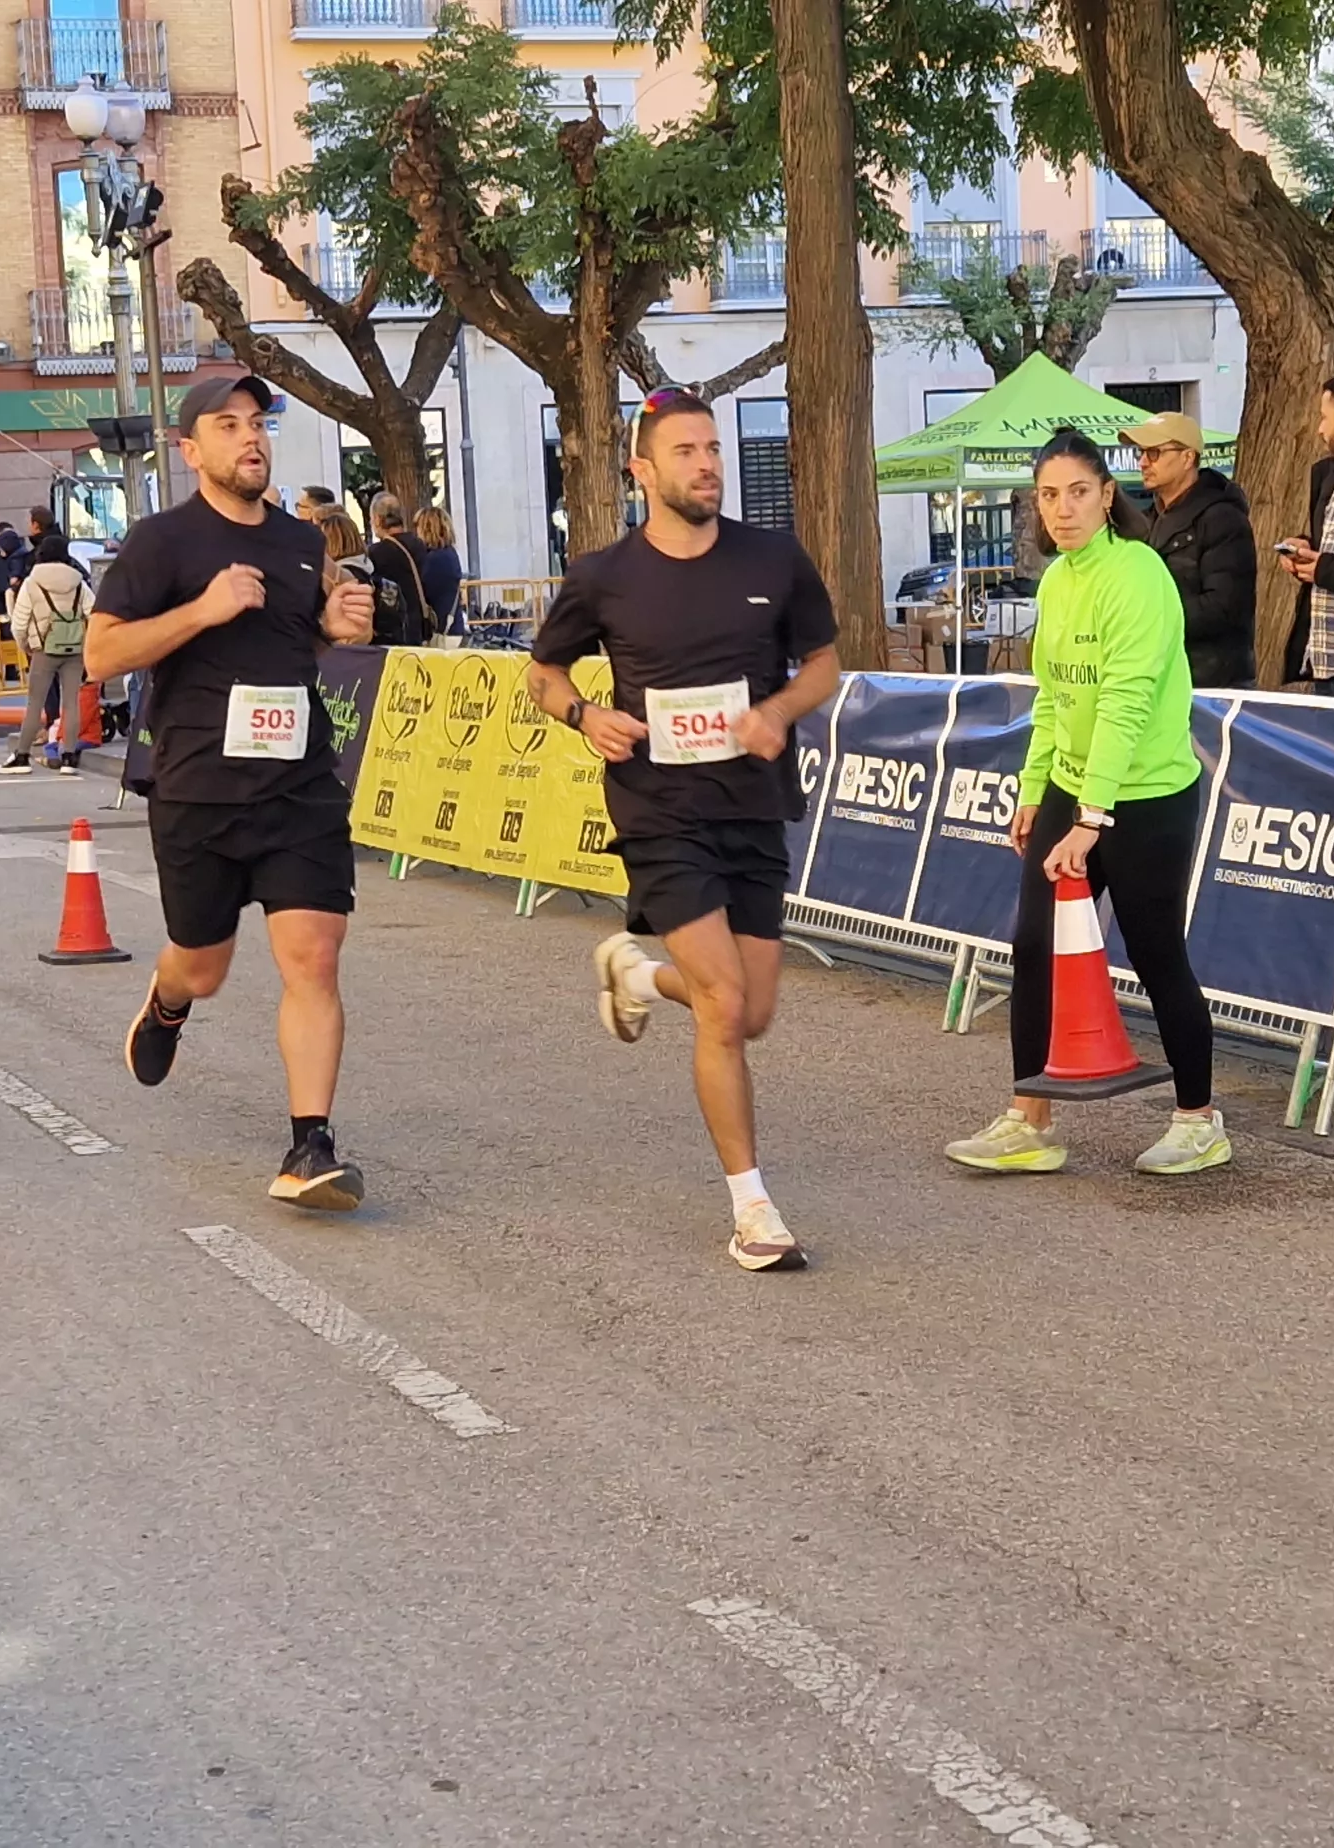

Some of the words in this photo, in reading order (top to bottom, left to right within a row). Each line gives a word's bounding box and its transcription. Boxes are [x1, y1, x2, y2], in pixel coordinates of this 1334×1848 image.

[1149, 367, 1157, 381] 2
[1046, 414, 1140, 426] FARTLECK
[250, 708, 295, 730] 503
[671, 711, 729, 736] 504
[857, 756, 926, 812] ESIC
[970, 769, 1019, 827] ES
